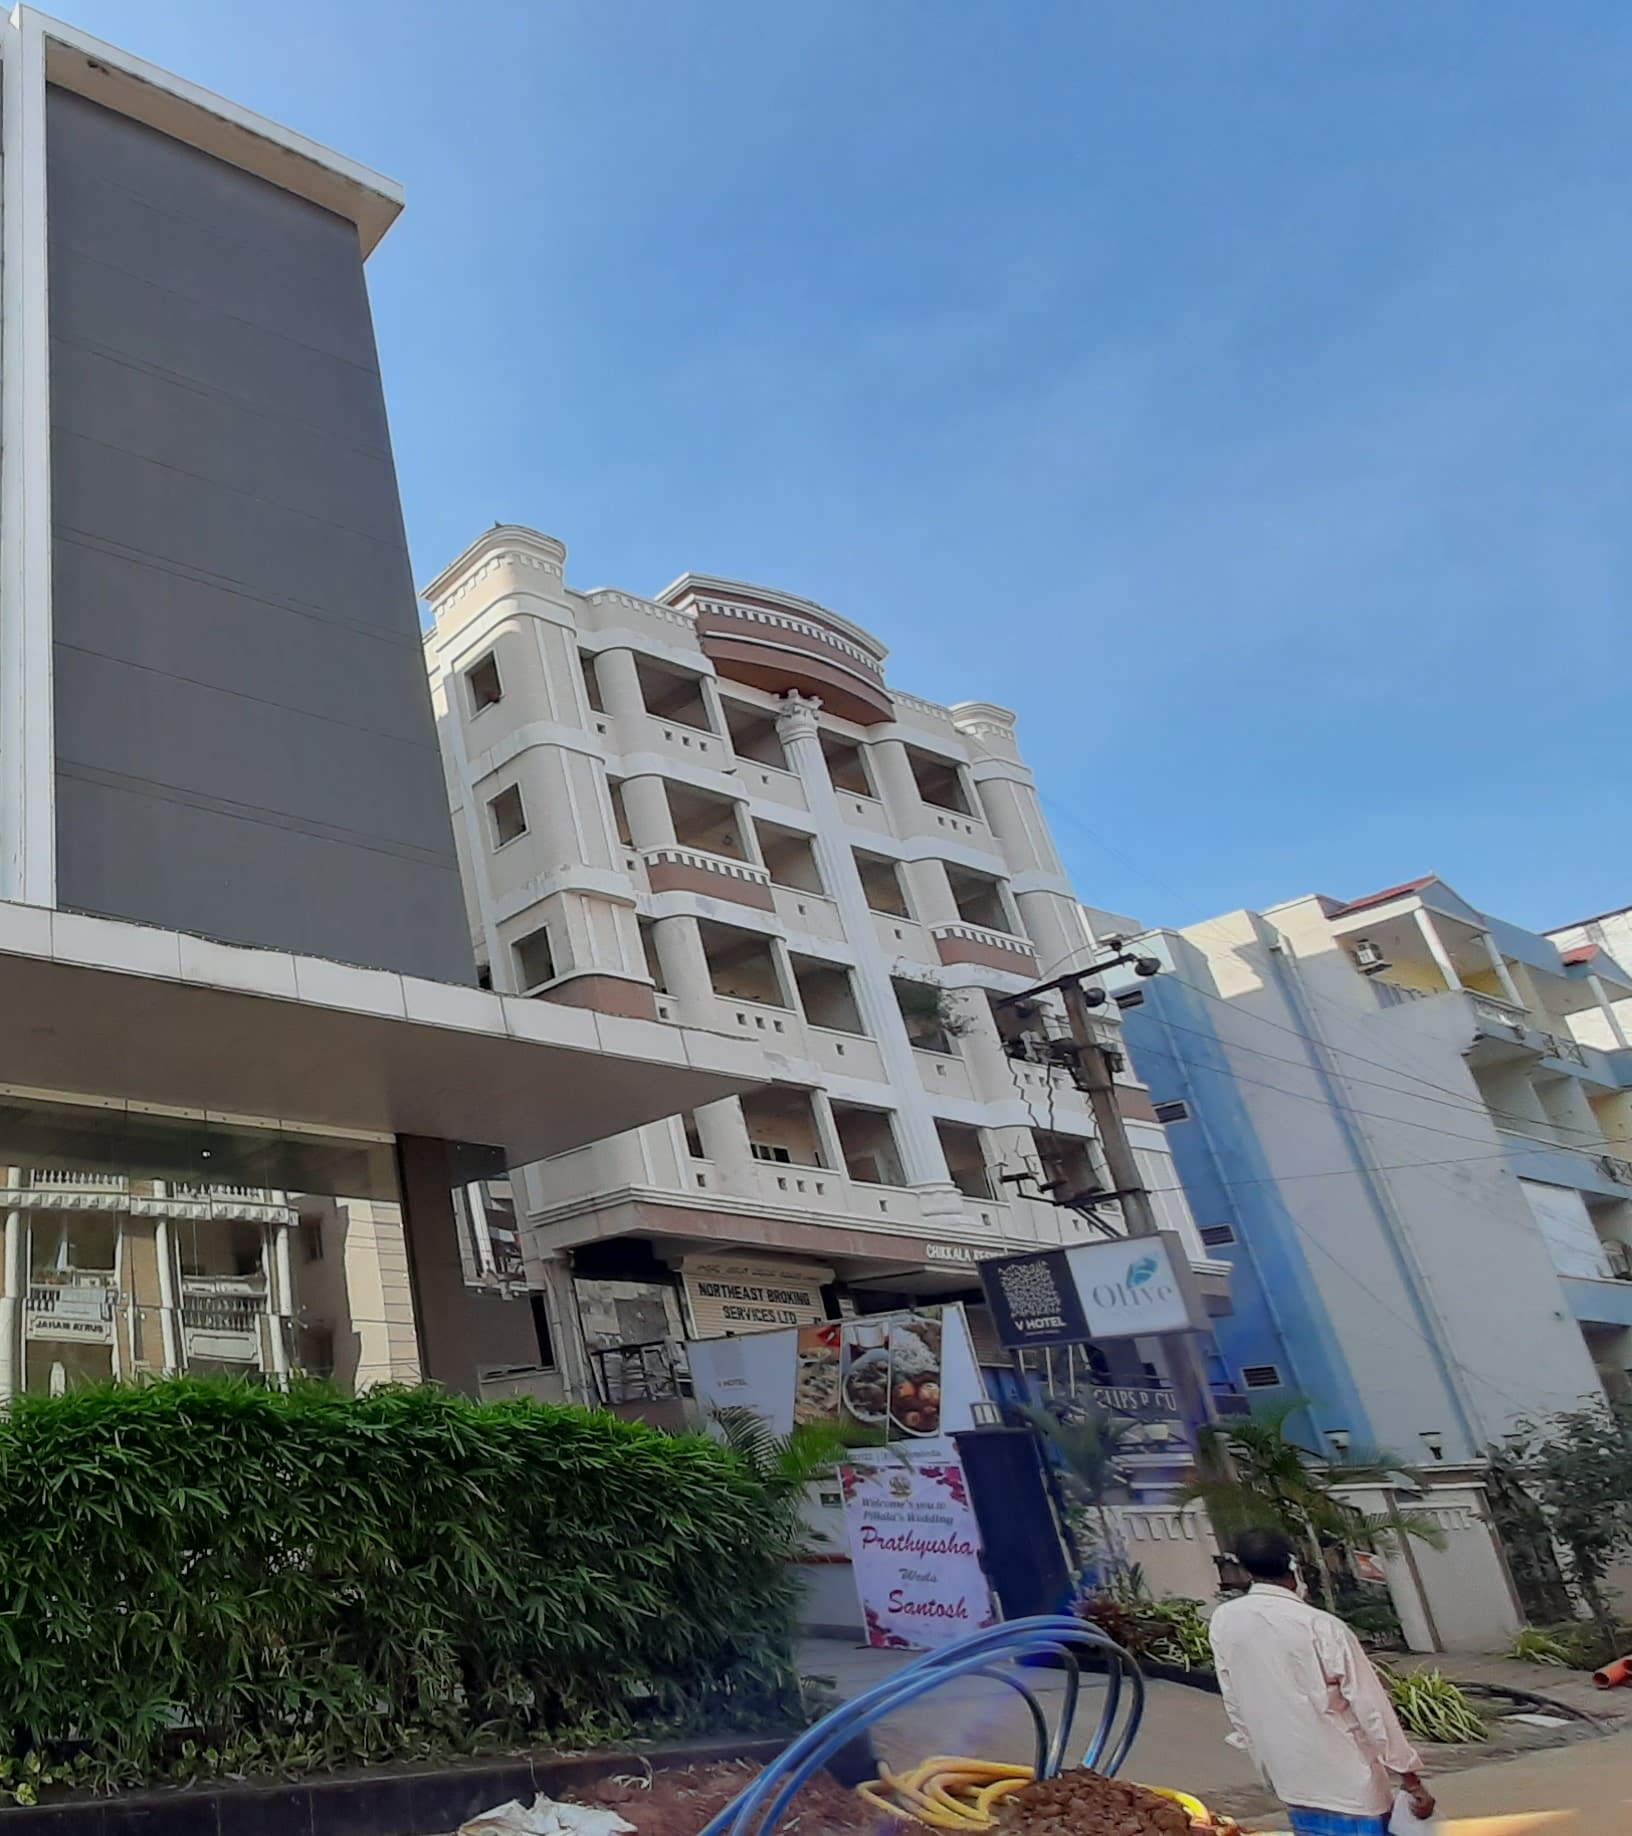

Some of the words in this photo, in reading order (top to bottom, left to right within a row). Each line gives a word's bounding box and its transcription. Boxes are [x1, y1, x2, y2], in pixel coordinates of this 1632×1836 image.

[698, 1282, 765, 1301] NORTHEAST
[767, 1288, 811, 1306] BROKING
[1092, 1282, 1172, 1309] Olive
[723, 1305, 777, 1323] SERVICES
[778, 1310, 798, 1324] LTD
[1015, 1320, 1026, 1331] V
[1026, 1316, 1066, 1329] HOTEL
[1093, 1389, 1138, 1409] CLIPS
[860, 1525, 974, 1559] Prathyusha
[899, 1568, 938, 1583] Weds
[888, 1589, 969, 1619] Santosh
